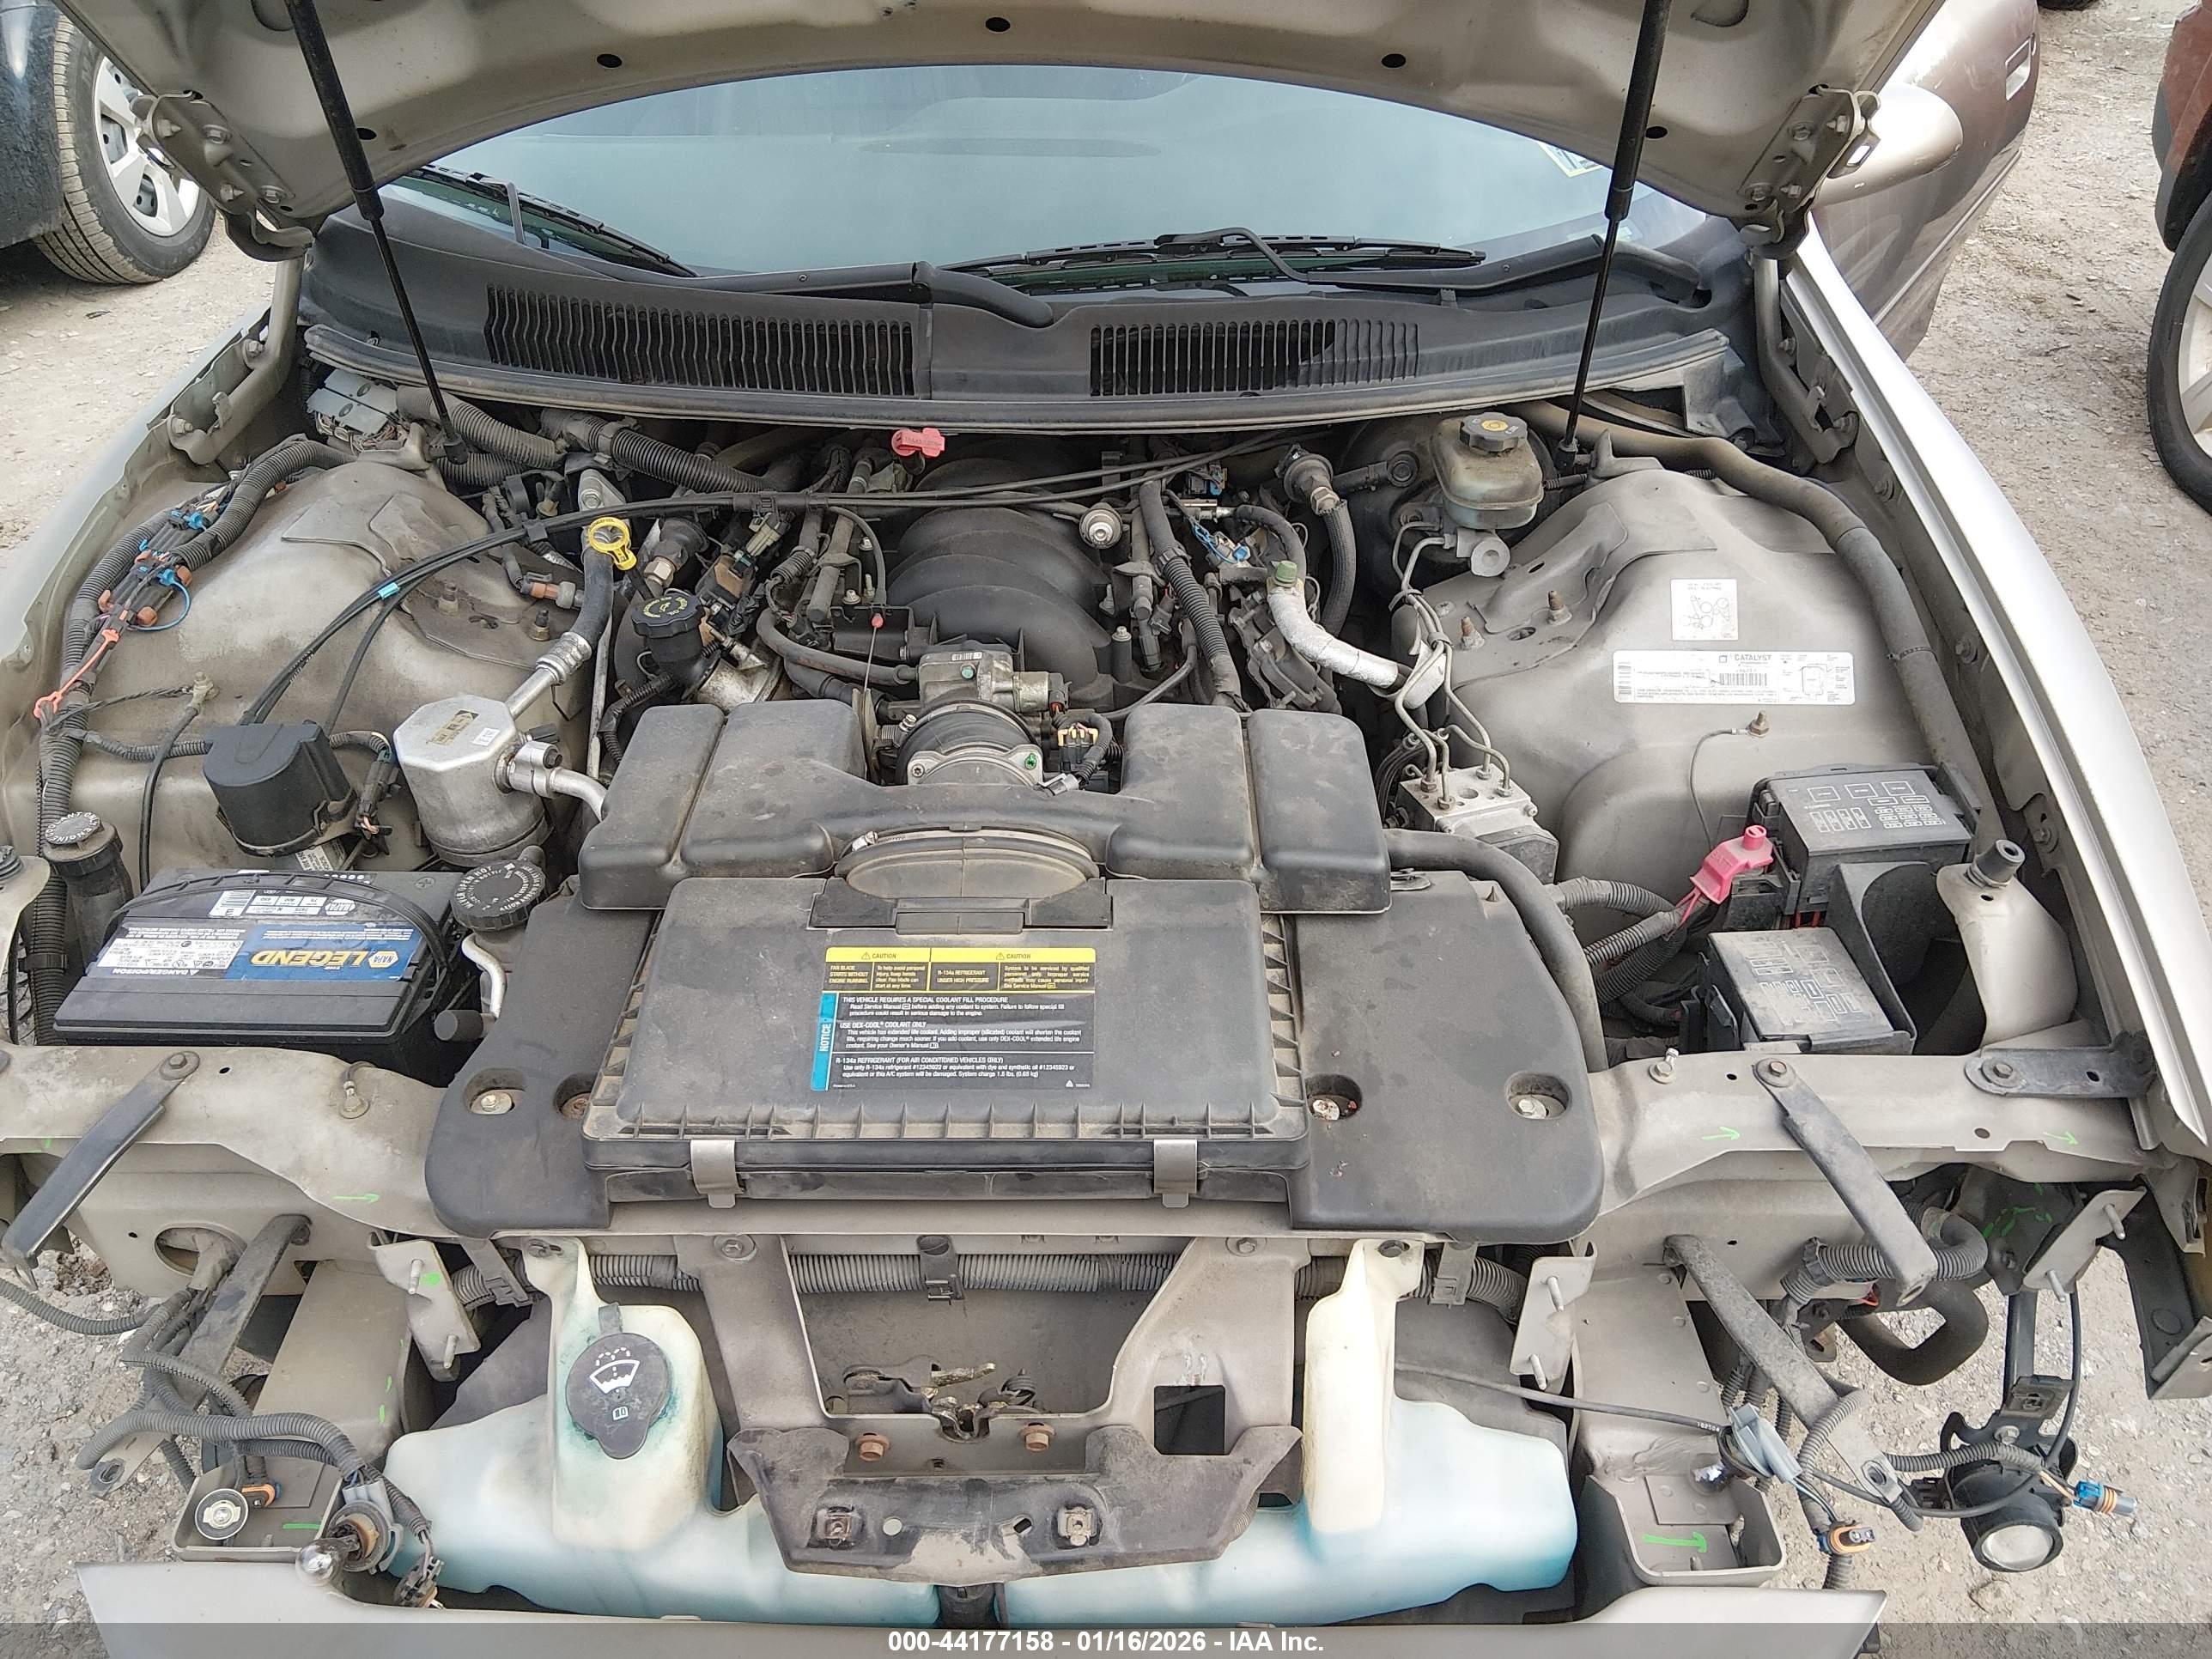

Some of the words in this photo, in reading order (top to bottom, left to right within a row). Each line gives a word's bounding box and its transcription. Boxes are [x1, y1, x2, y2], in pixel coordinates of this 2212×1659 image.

[473, 866, 492, 877] HOT
[251, 950, 369, 967] LEGEND
[373, 955, 394, 963] NAPA
[818, 1023, 832, 1052] NOTICE
